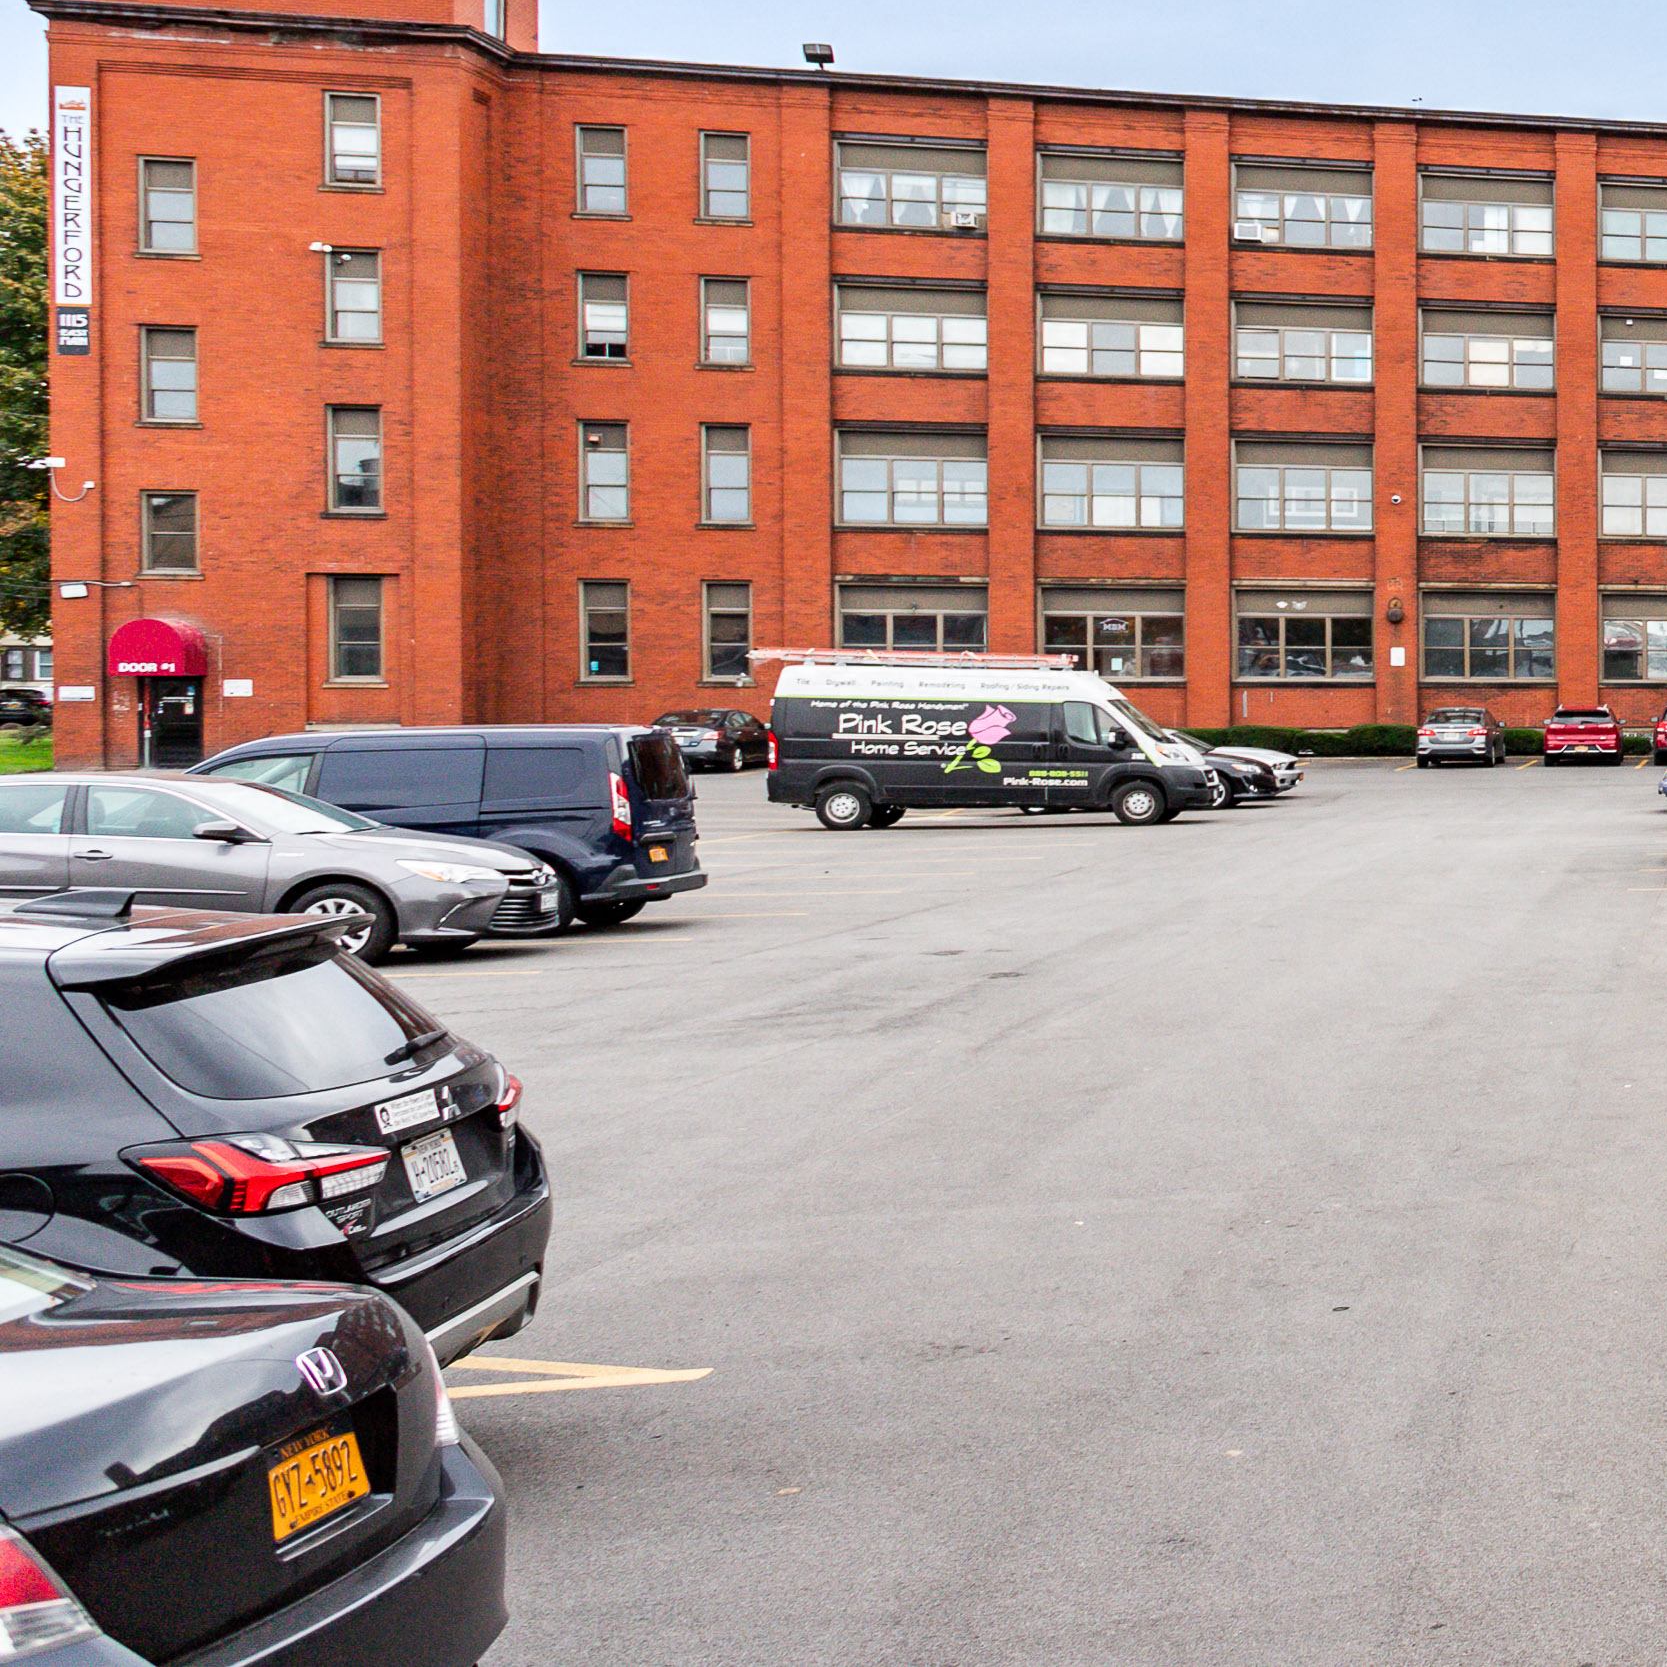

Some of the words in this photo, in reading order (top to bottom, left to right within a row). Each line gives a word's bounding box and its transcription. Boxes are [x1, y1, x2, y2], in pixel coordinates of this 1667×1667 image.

[63, 126, 83, 298] HUNGERFORD
[59, 314, 88, 328] 1115
[118, 662, 158, 672] DOOR
[160, 662, 176, 672] #1
[838, 713, 893, 734] Pink
[901, 714, 968, 736] Rose
[851, 740, 900, 755] Home
[903, 741, 966, 756] Service
[1003, 777, 1089, 787] Pink-Rose.com
